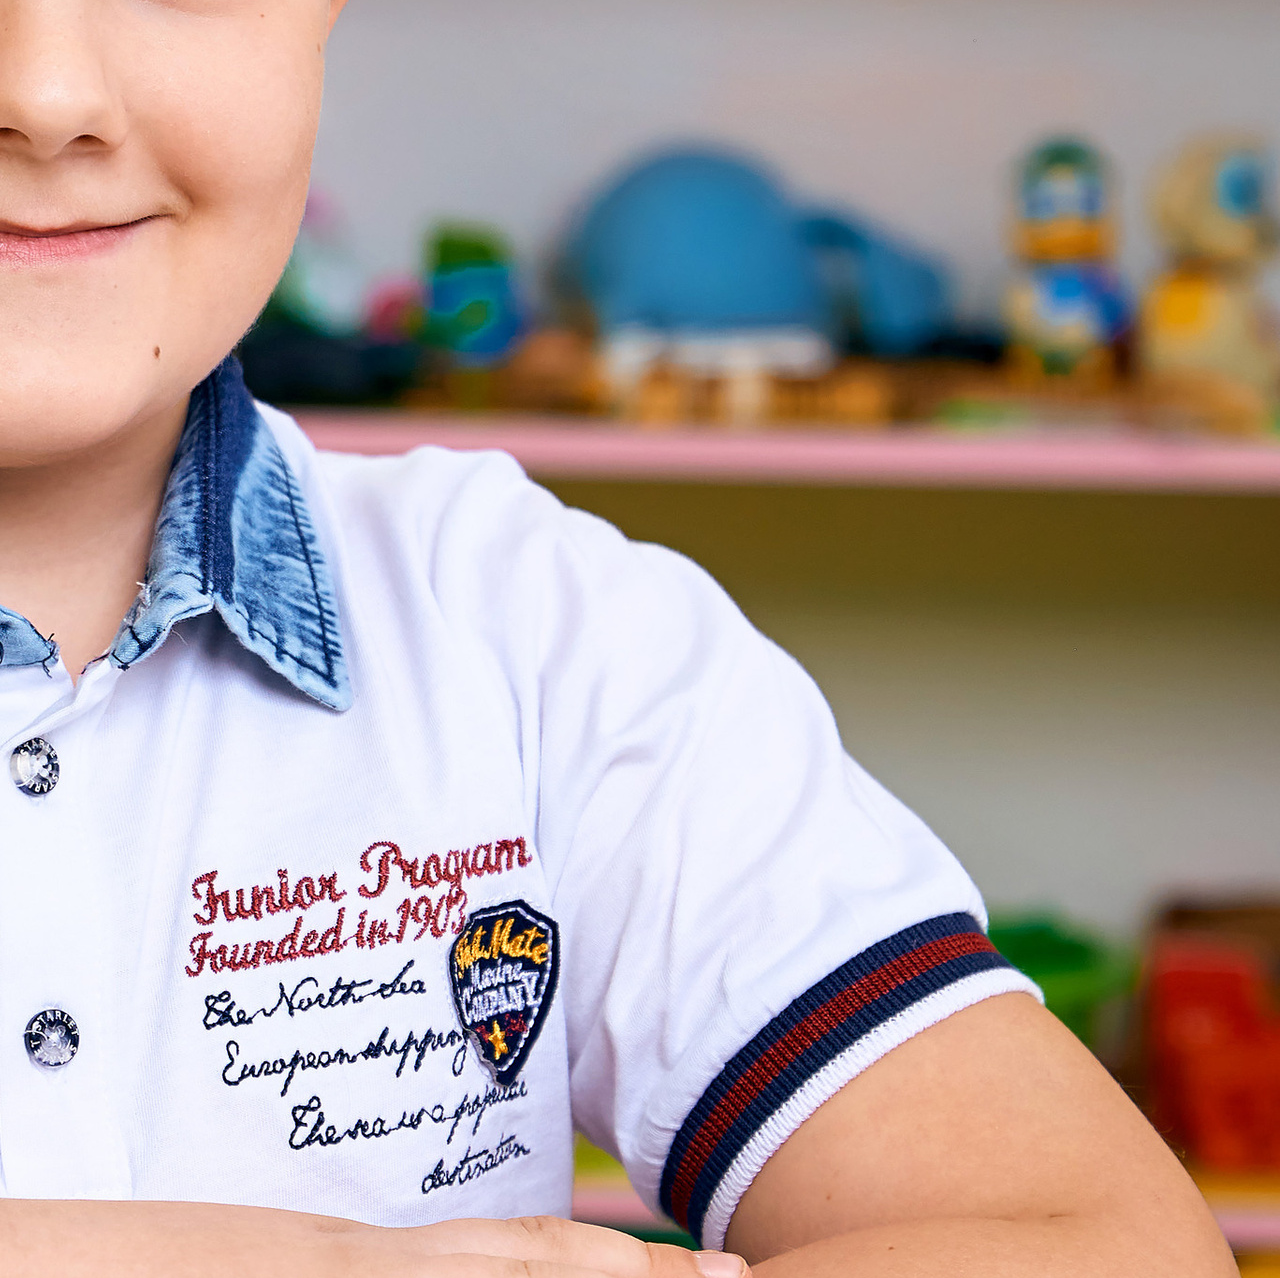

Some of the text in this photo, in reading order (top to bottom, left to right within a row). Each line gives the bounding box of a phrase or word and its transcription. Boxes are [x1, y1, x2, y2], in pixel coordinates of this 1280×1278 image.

[192, 836, 533, 926] Junior Program
[185, 906, 348, 978] Founded
